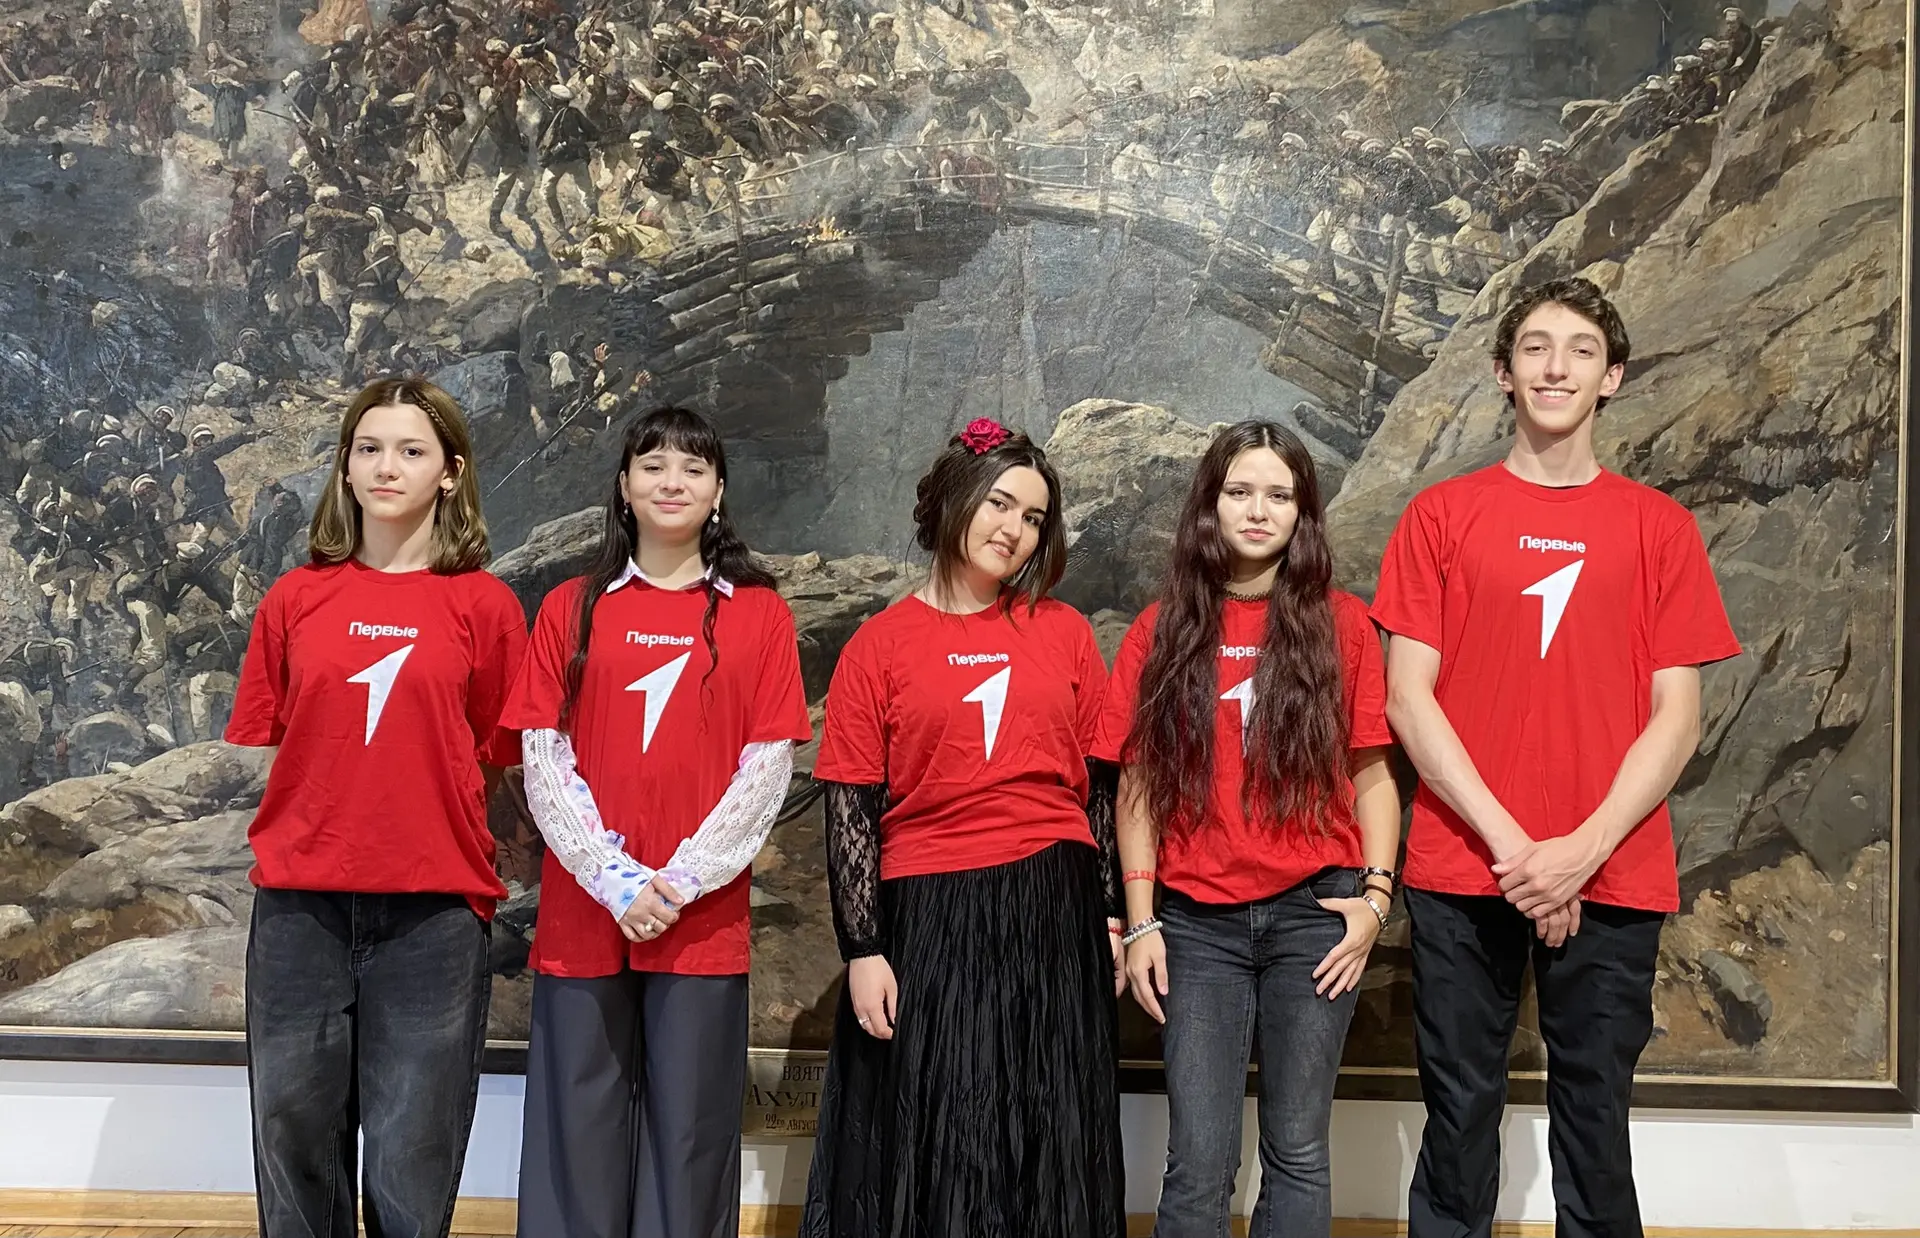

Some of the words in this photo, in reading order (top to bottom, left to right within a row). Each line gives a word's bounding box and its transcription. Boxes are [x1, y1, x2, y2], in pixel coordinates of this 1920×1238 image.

[1520, 535, 1586, 553] Первые
[349, 621, 418, 640] Первые
[626, 631, 694, 648] Первые
[947, 652, 1010, 667] Первые
